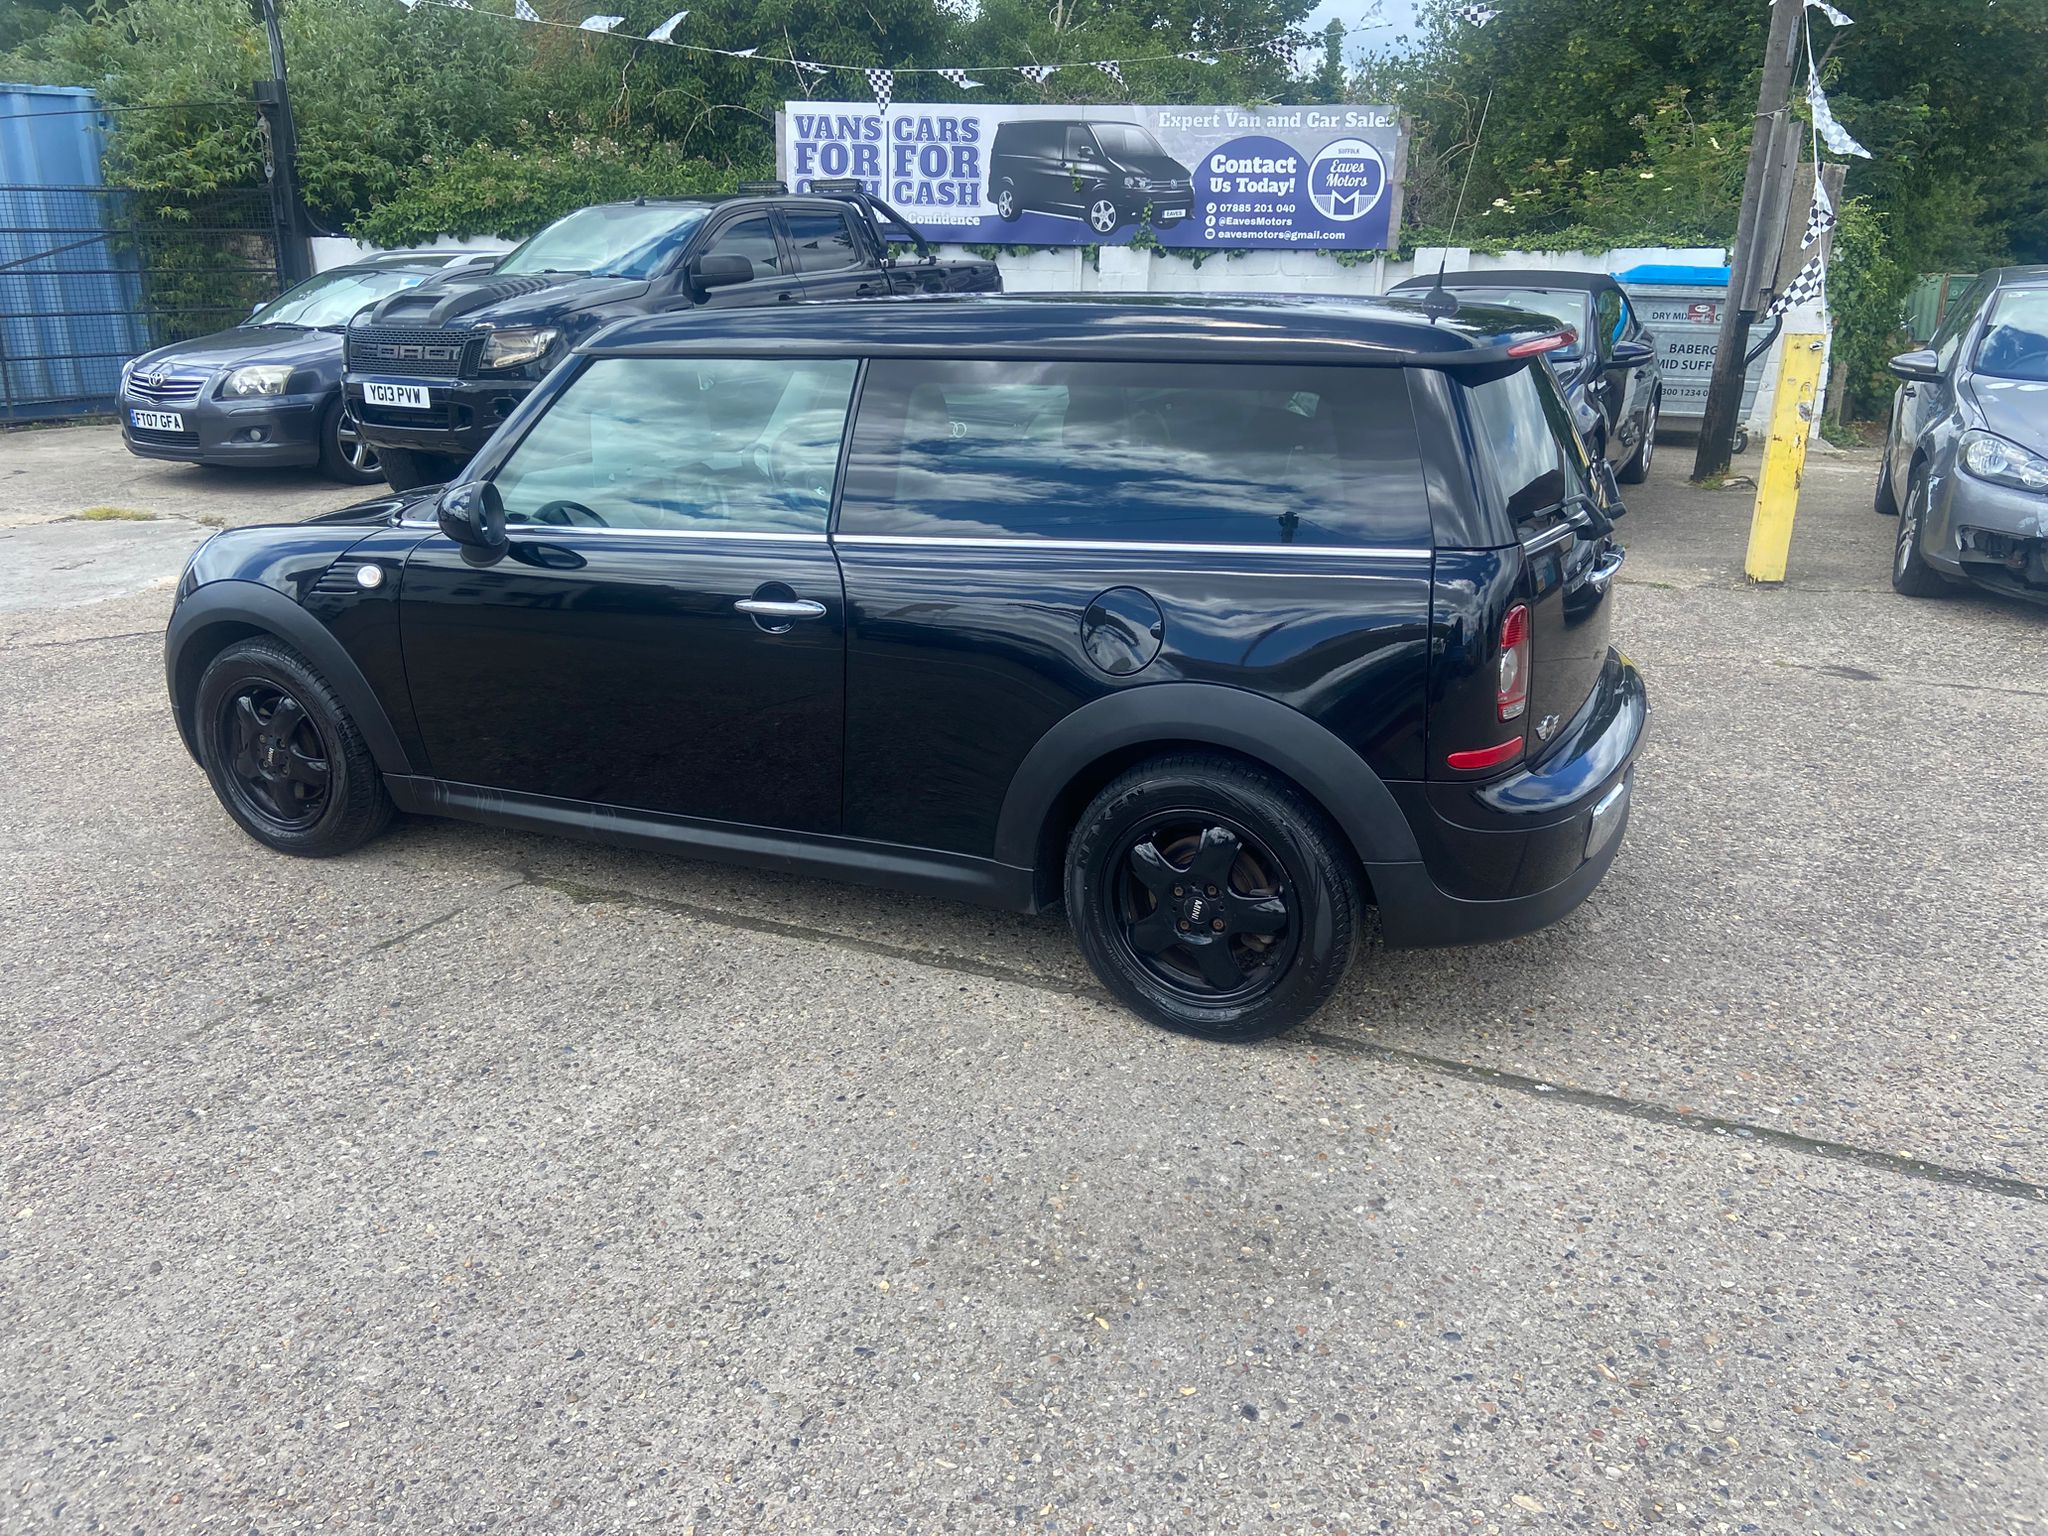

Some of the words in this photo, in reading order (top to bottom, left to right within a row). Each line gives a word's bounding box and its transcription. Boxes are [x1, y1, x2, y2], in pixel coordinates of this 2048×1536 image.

[794, 114, 882, 141] VANS
[893, 116, 980, 143] CARS
[1158, 112, 1220, 131] Expert
[1226, 112, 1261, 128] Van
[1266, 113, 1301, 128] and
[1306, 112, 1340, 128] Car
[1344, 112, 1395, 128] Sales
[794, 142, 881, 176] FOR
[893, 144, 980, 179] FOR
[1210, 154, 1297, 174] Contact
[1330, 159, 1365, 173] Eaves
[796, 178, 881, 197] CH
[1210, 178, 1232, 193] Us
[1236, 177, 1296, 197] Today!
[1326, 173, 1368, 187] Motors
[893, 181, 980, 208] CASH
[1219, 204, 1251, 213] 07885
[1253, 204, 1274, 213] 201
[1276, 204, 1296, 213] 040
[908, 212, 981, 226] Confidence
[1218, 217, 1293, 227] @EavesMotors
[1217, 230, 1346, 241] eavesmotors@gmail.com
[1652, 312, 1671, 320] DRY
[1669, 343, 1719, 355] BABERG
[1681, 360, 1714, 371] SUFF
[369, 384, 395, 402] YG13
[396, 386, 421, 404] PVW
[1661, 388, 1678, 396] 300
[1680, 389, 1701, 397] 1234
[135, 412, 158, 427] FT07
[159, 415, 182, 429] GFA
[1191, 899, 1203, 920] MINI
